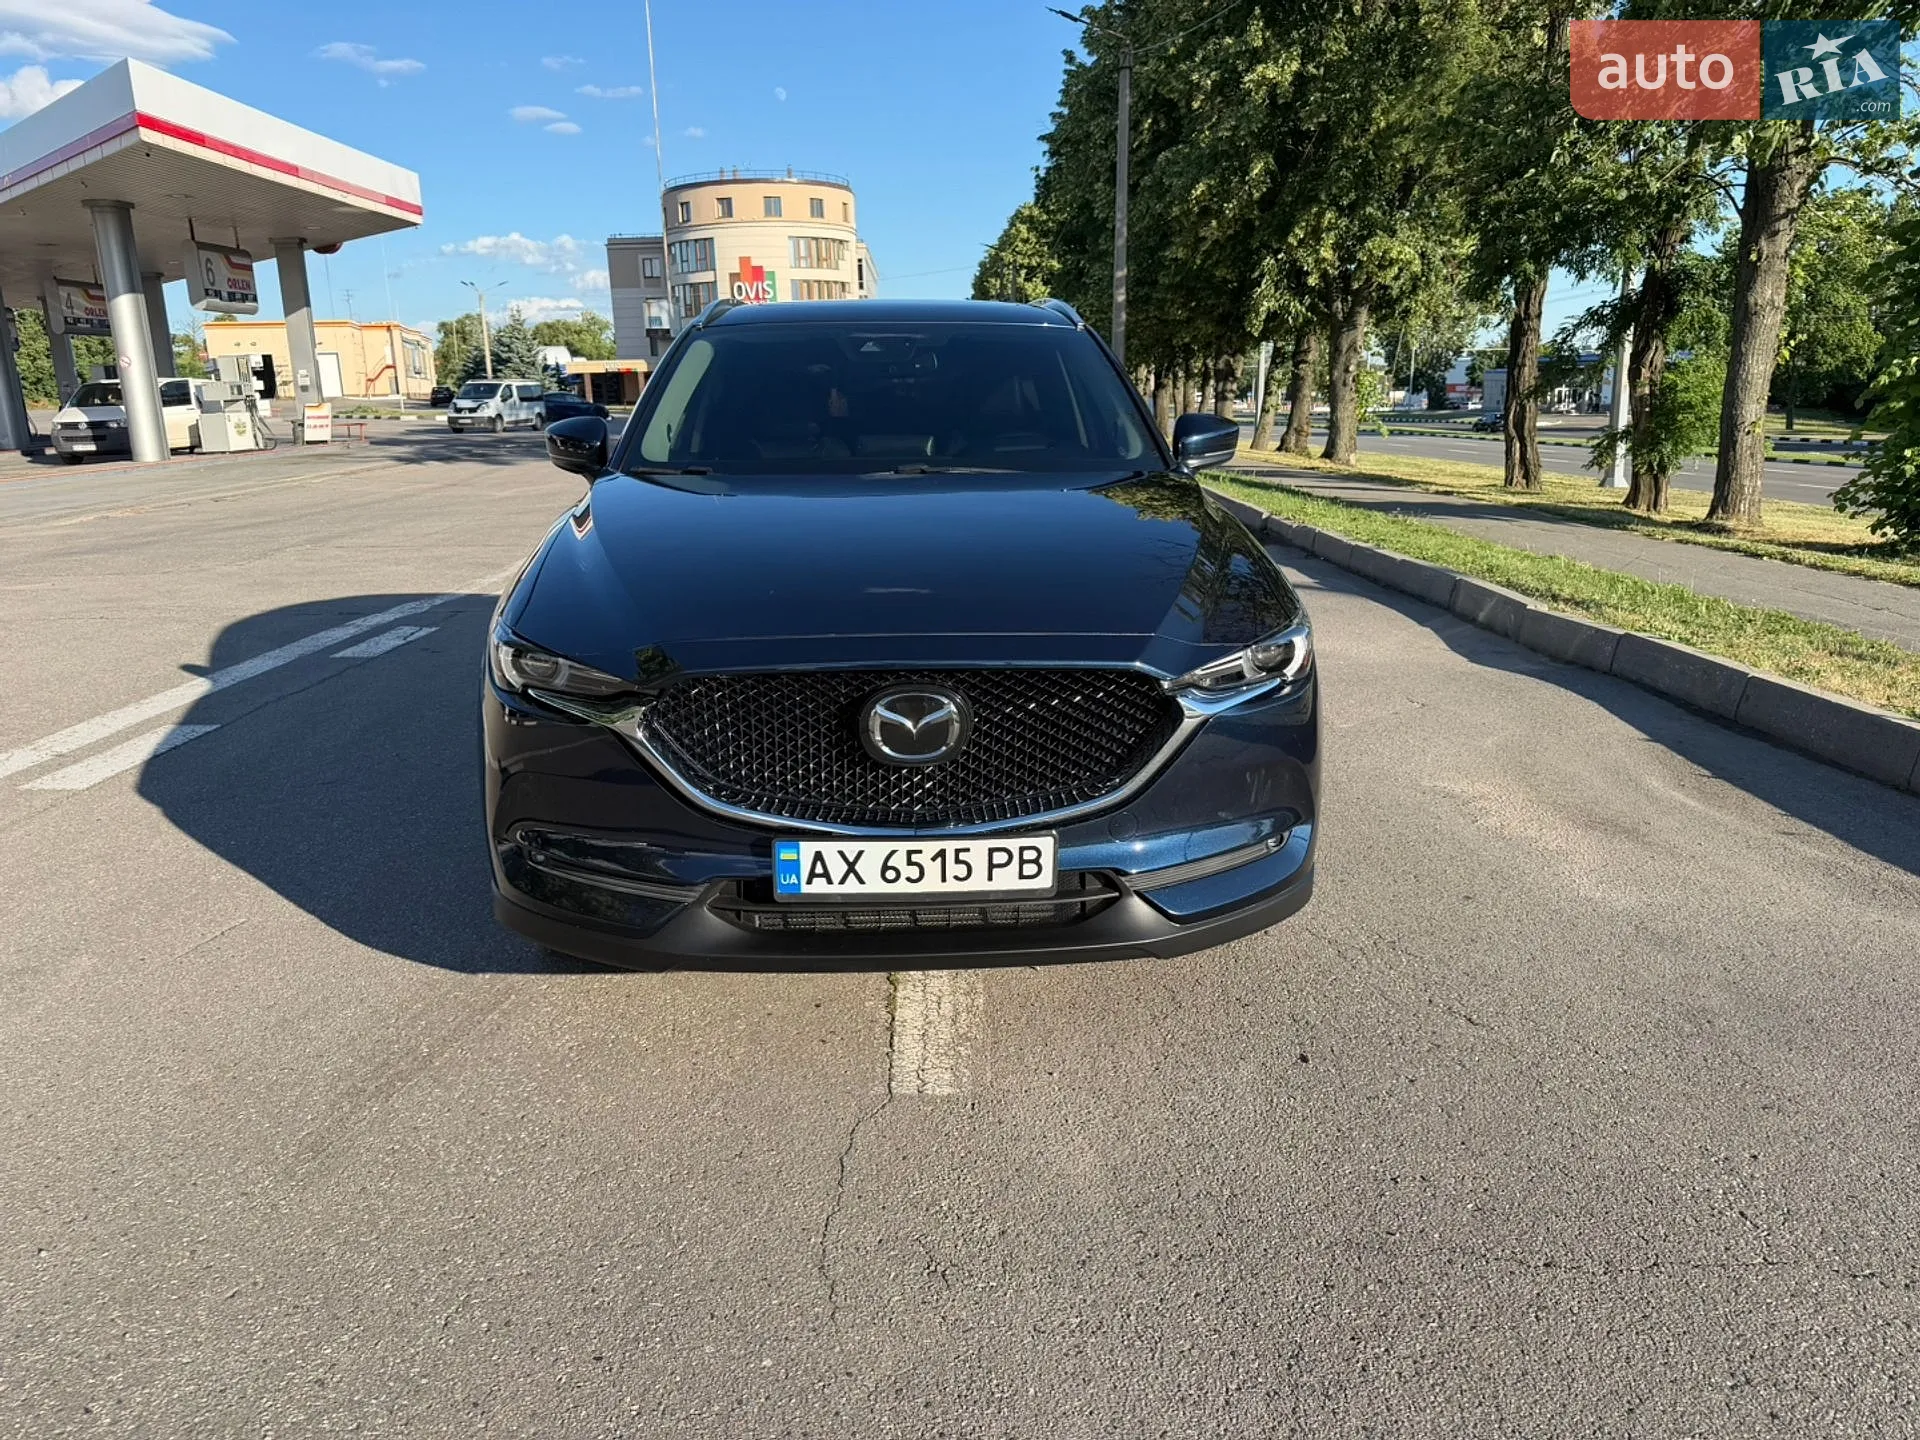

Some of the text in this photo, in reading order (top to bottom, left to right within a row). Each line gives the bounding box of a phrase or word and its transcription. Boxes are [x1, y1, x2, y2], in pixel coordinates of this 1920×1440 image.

[205, 257, 216, 287] 6
[227, 277, 251, 291] ORLEN
[733, 280, 774, 300] OVIS
[65, 292, 74, 316] 4
[805, 845, 1043, 885] AX 6515 PB
[780, 873, 799, 885] UA
